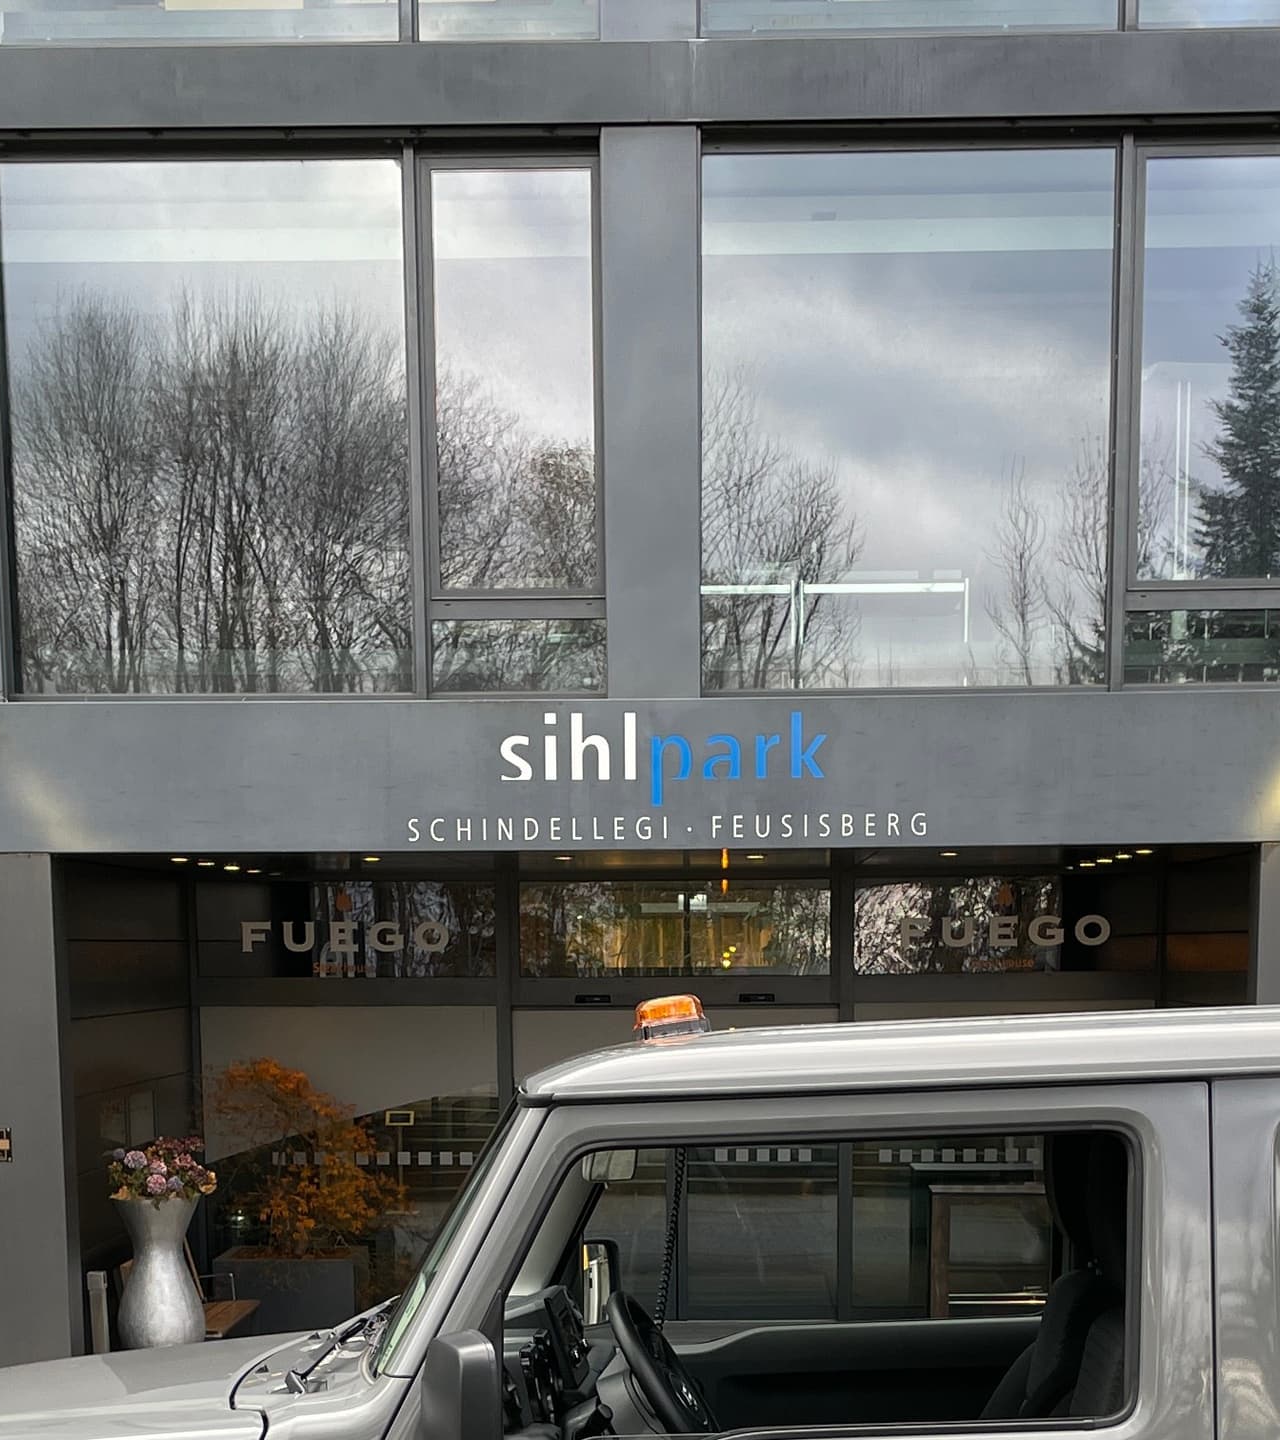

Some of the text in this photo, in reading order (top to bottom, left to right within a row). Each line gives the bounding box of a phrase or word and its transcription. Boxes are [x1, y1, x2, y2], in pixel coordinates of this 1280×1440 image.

[499, 711, 828, 807] sihlpark
[408, 812, 928, 843] SCHINDELLEGI FEUSISBERG
[240, 920, 451, 953] FUEGO
[901, 914, 1111, 949] FUEGO
